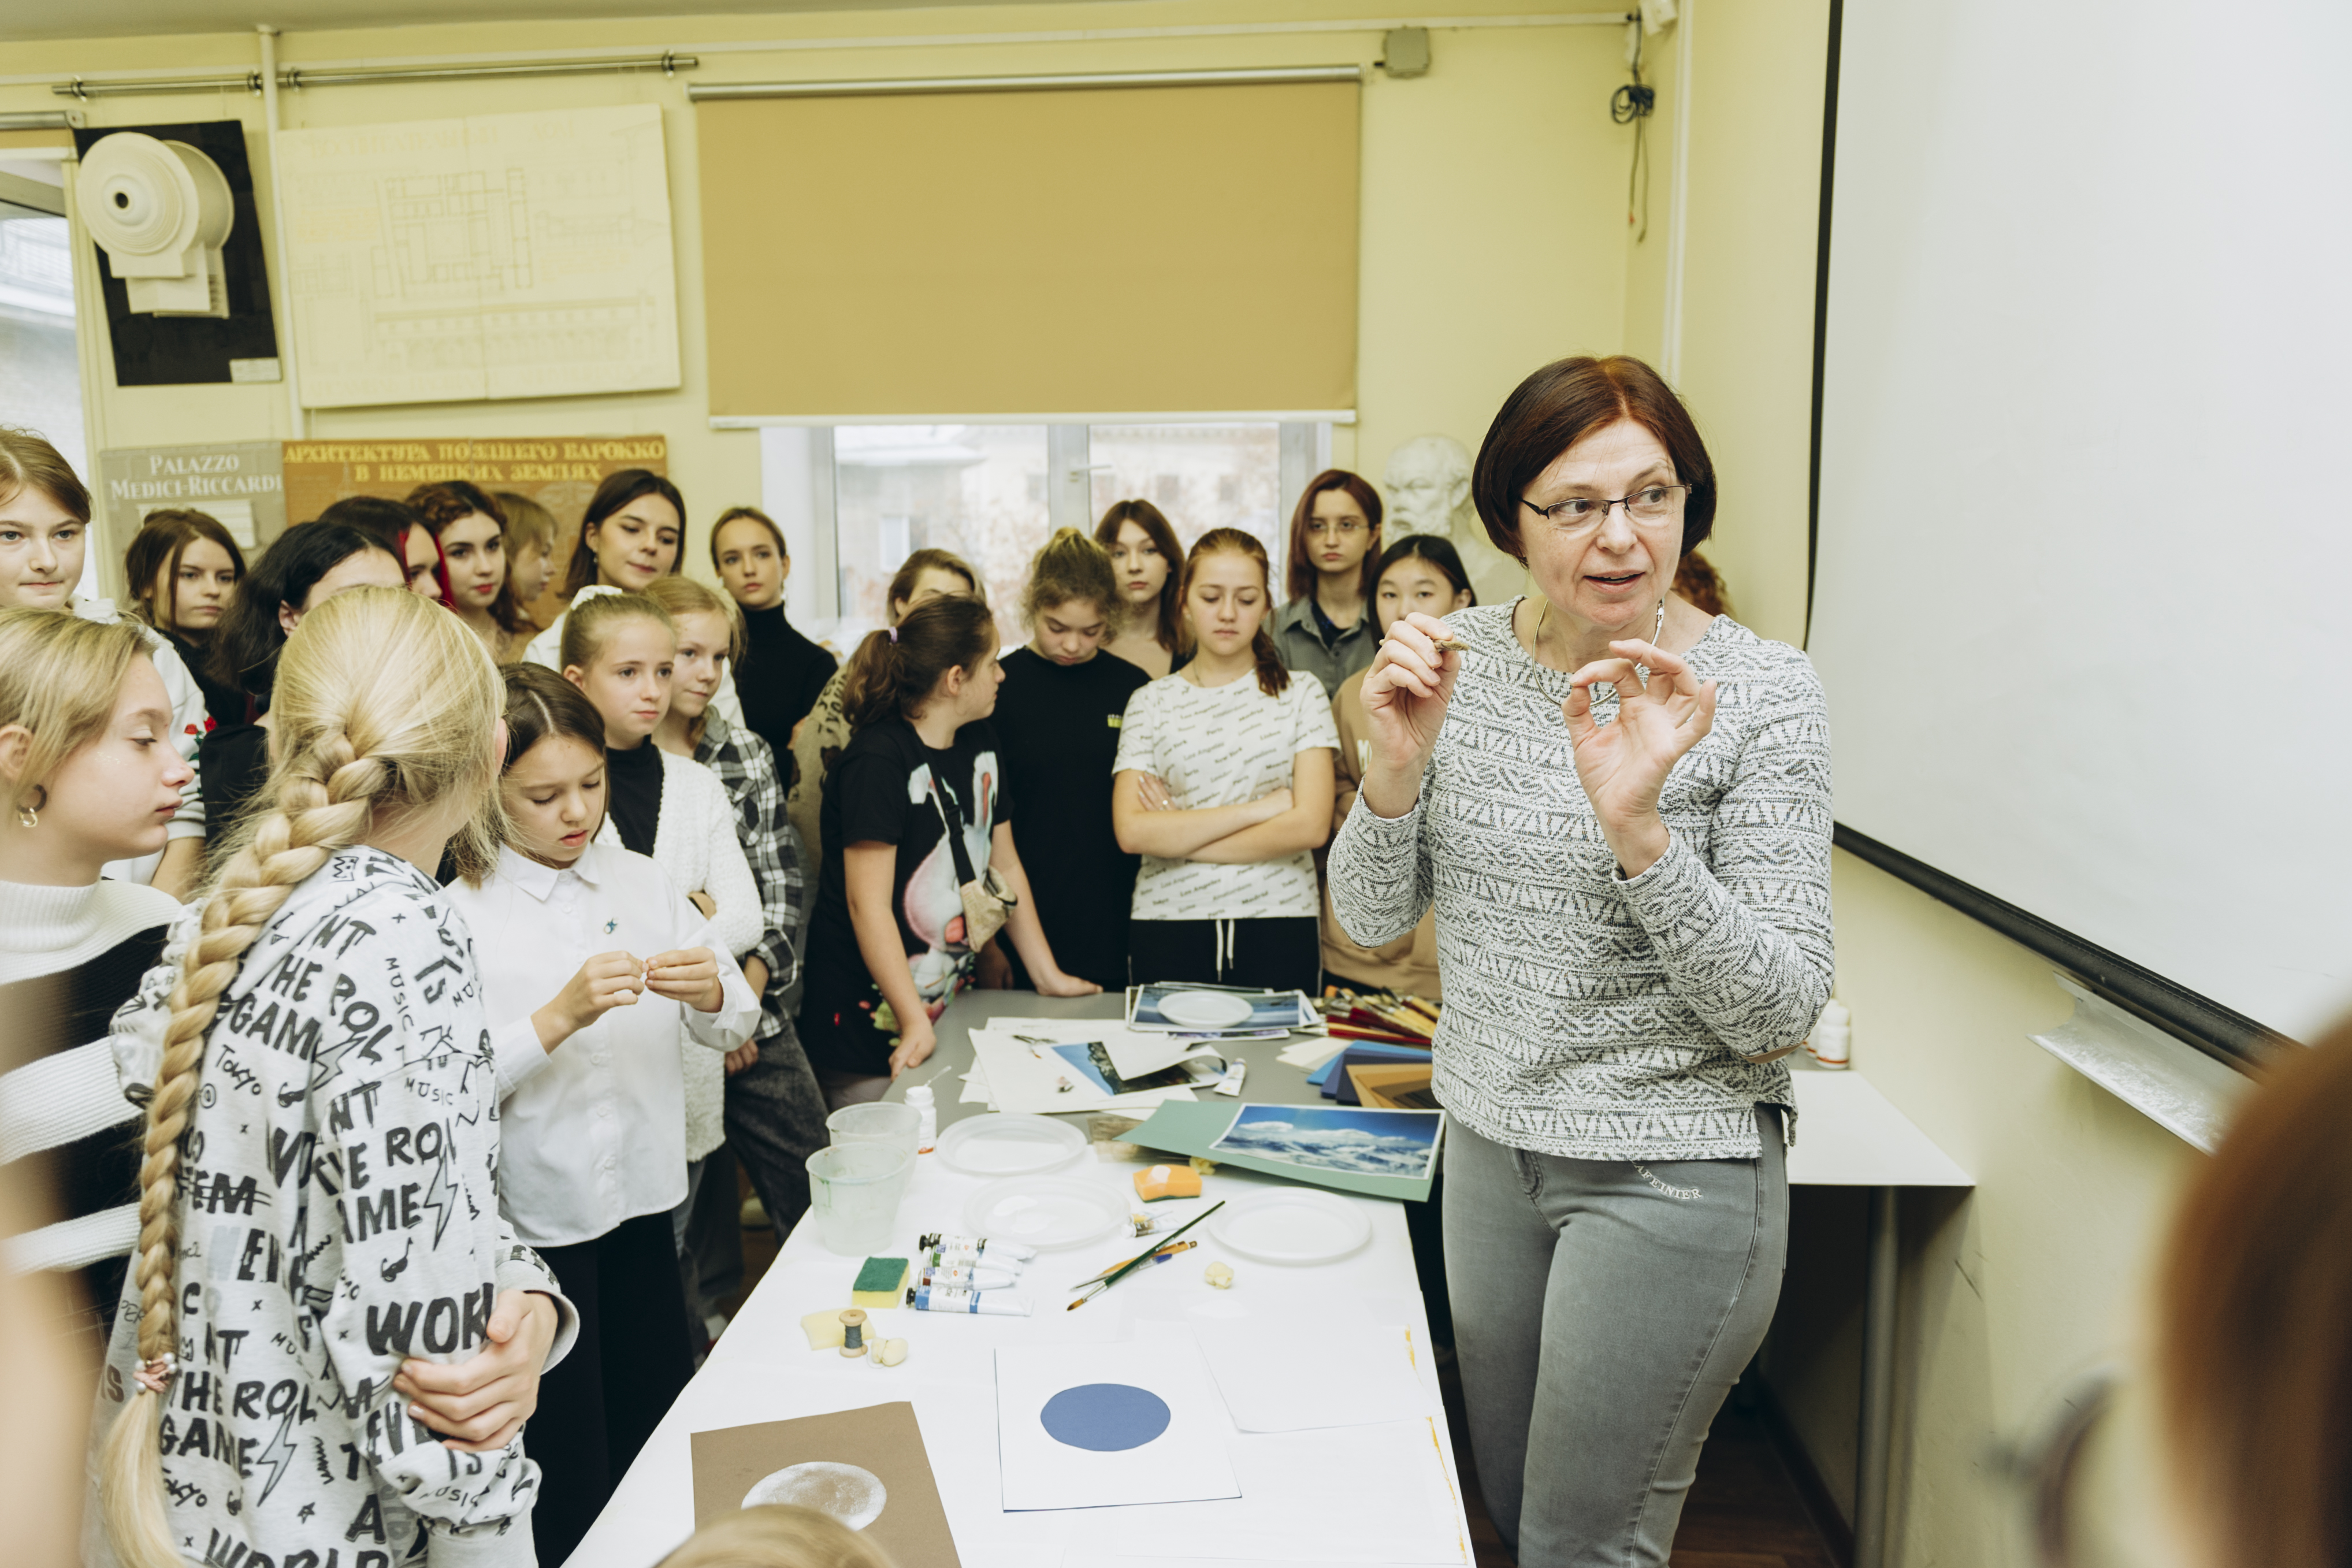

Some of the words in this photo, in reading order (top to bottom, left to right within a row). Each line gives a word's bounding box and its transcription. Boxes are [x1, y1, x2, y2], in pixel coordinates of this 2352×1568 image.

[284, 443, 431, 463] АРХИТЕКТУРА
[562, 440, 664, 461] БАРОККО
[354, 463, 370, 482] В
[379, 463, 504, 482] НЕМЕЦКИХ
[511, 463, 602, 482] ЗЕМЛЯХ
[385, 957, 414, 1032] MUSIC
[229, 992, 321, 1062] GAM
[404, 1077, 453, 1106] MUSIC
